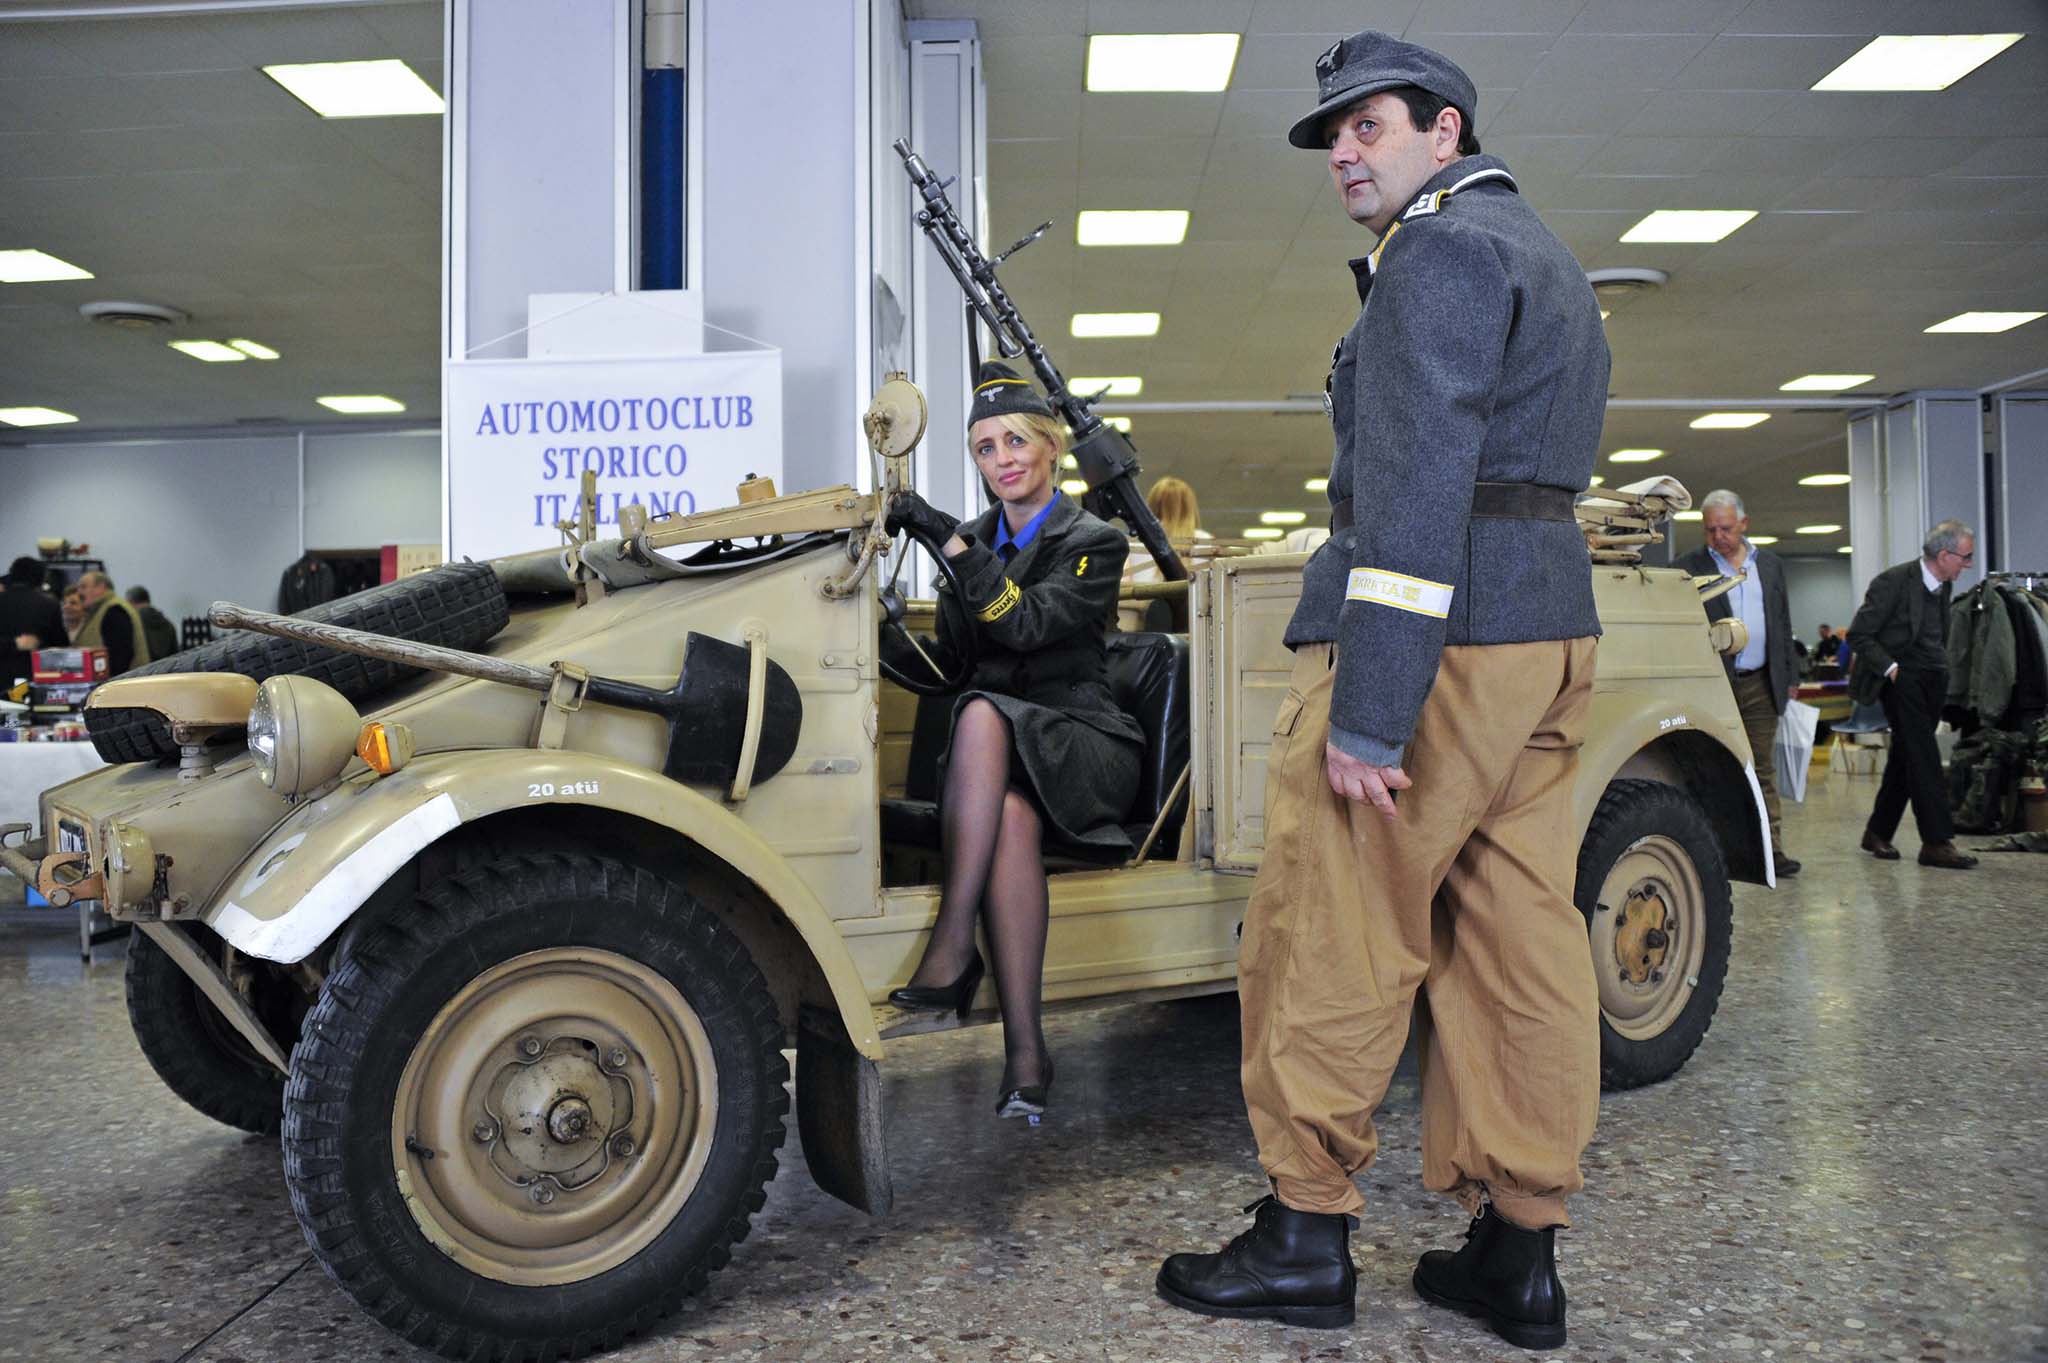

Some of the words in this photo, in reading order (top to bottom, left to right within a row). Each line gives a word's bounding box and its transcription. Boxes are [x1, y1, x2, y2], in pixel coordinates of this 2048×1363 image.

[476, 395, 753, 435] AUTOMOTOCLUB
[543, 443, 687, 480] STORICO
[1660, 718, 1671, 730] 20
[527, 783, 555, 798] 20
[560, 780, 600, 796] atü
